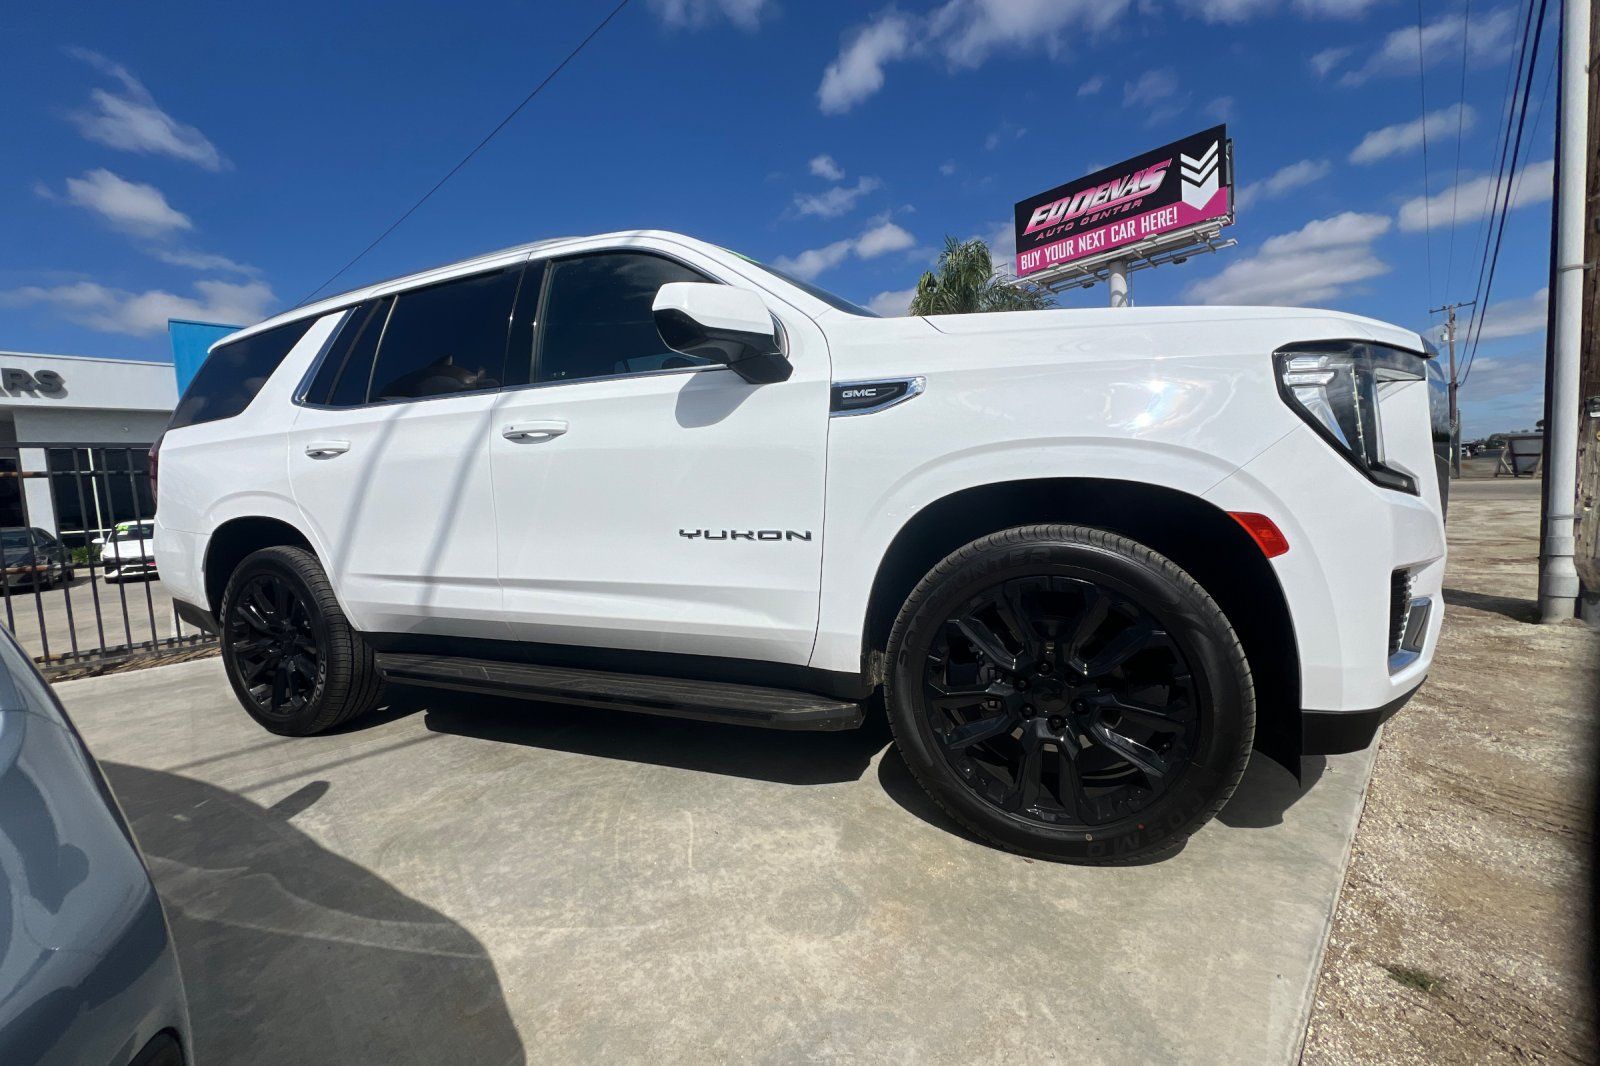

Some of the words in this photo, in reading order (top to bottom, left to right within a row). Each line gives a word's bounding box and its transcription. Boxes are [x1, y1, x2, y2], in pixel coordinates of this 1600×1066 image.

[1035, 221, 1075, 241] AUTO
[1080, 199, 1143, 226] CENTER
[1021, 252, 1041, 270] BUY
[1044, 242, 1074, 263] YOUR
[1078, 229, 1106, 253] NEXT
[1111, 219, 1136, 243] CAR
[1141, 206, 1178, 234] HERE!
[0, 367, 68, 399] RS
[842, 388, 877, 398] GMC
[679, 529, 812, 541] YUKON
